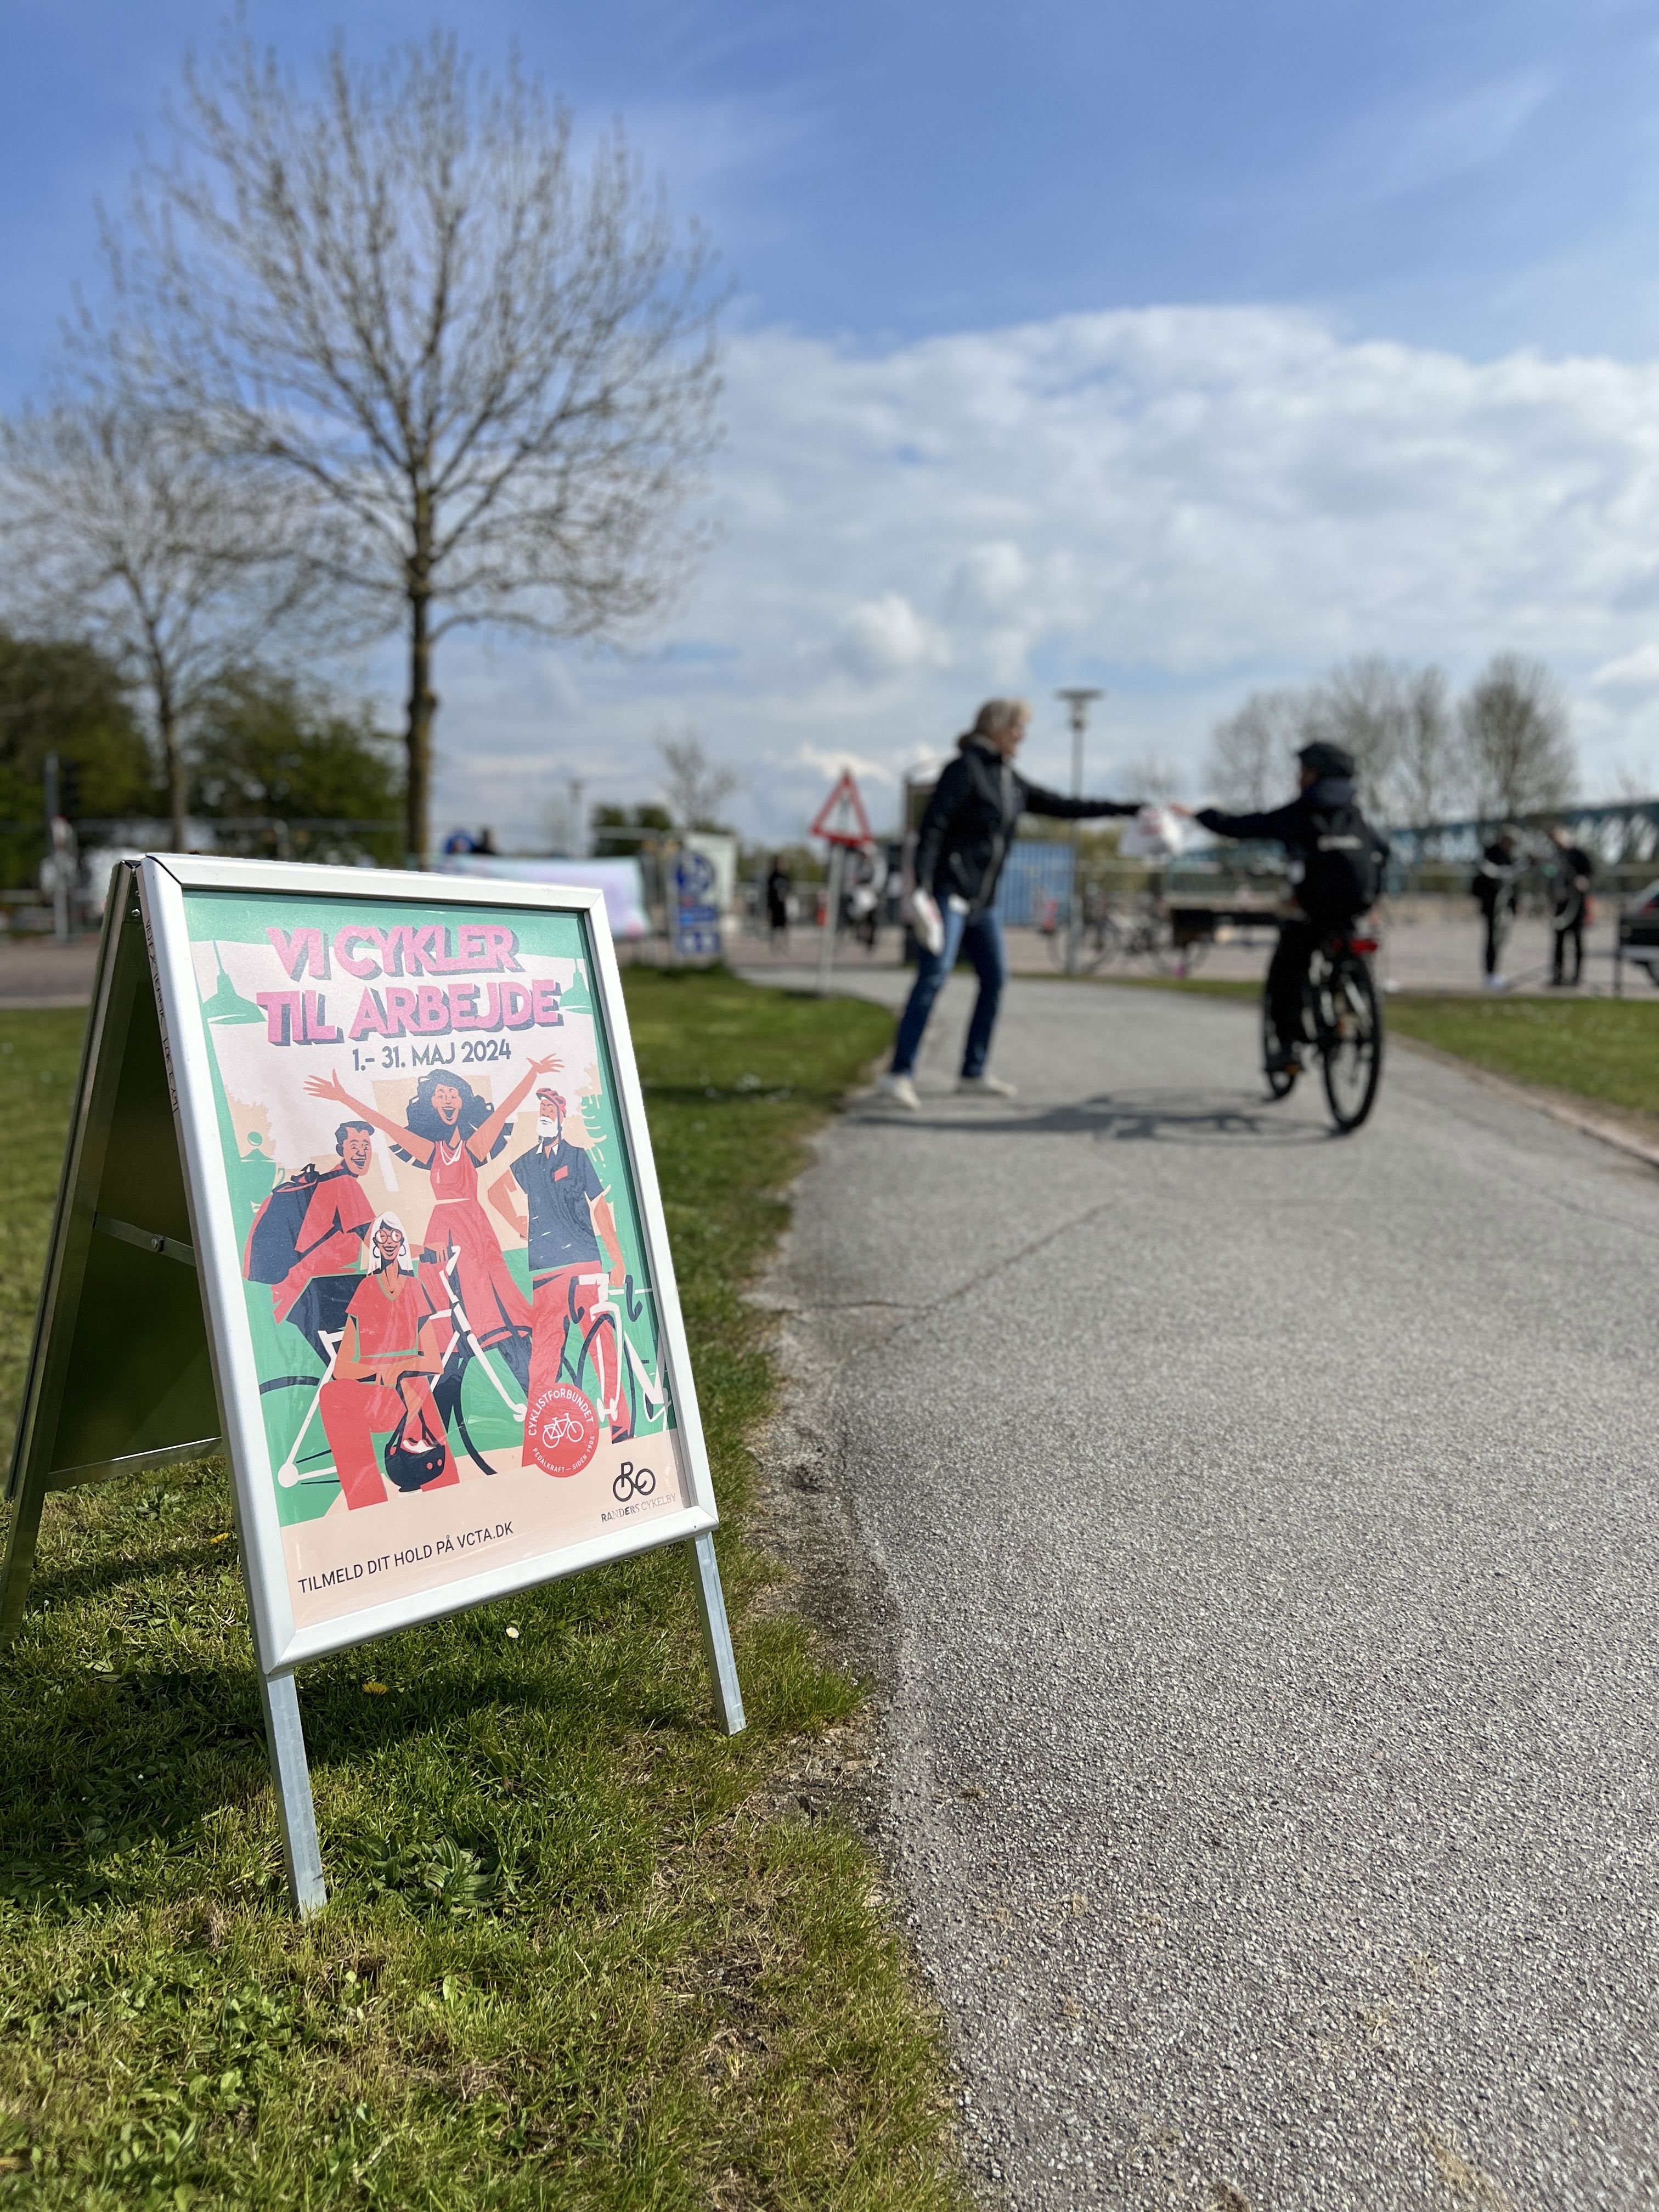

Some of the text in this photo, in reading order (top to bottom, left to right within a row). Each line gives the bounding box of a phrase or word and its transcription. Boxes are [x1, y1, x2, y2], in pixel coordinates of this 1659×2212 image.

[266, 925, 525, 981] VI CYKLER
[256, 979, 563, 1046] TIL ARBEJDE
[382, 1046, 406, 1068] 31.
[411, 1042, 455, 1066] MAJ
[461, 1039, 511, 1063] 2024
[532, 1447, 565, 1472] PEDALKRAFT
[572, 1455, 588, 1470] SIDEN
[586, 1435, 595, 1453] 1905
[601, 1493, 676, 1522] RANDERS CYKELBY
[298, 1521, 514, 1593] TILMELD DIT HOLD PÅ VCTA.DK
